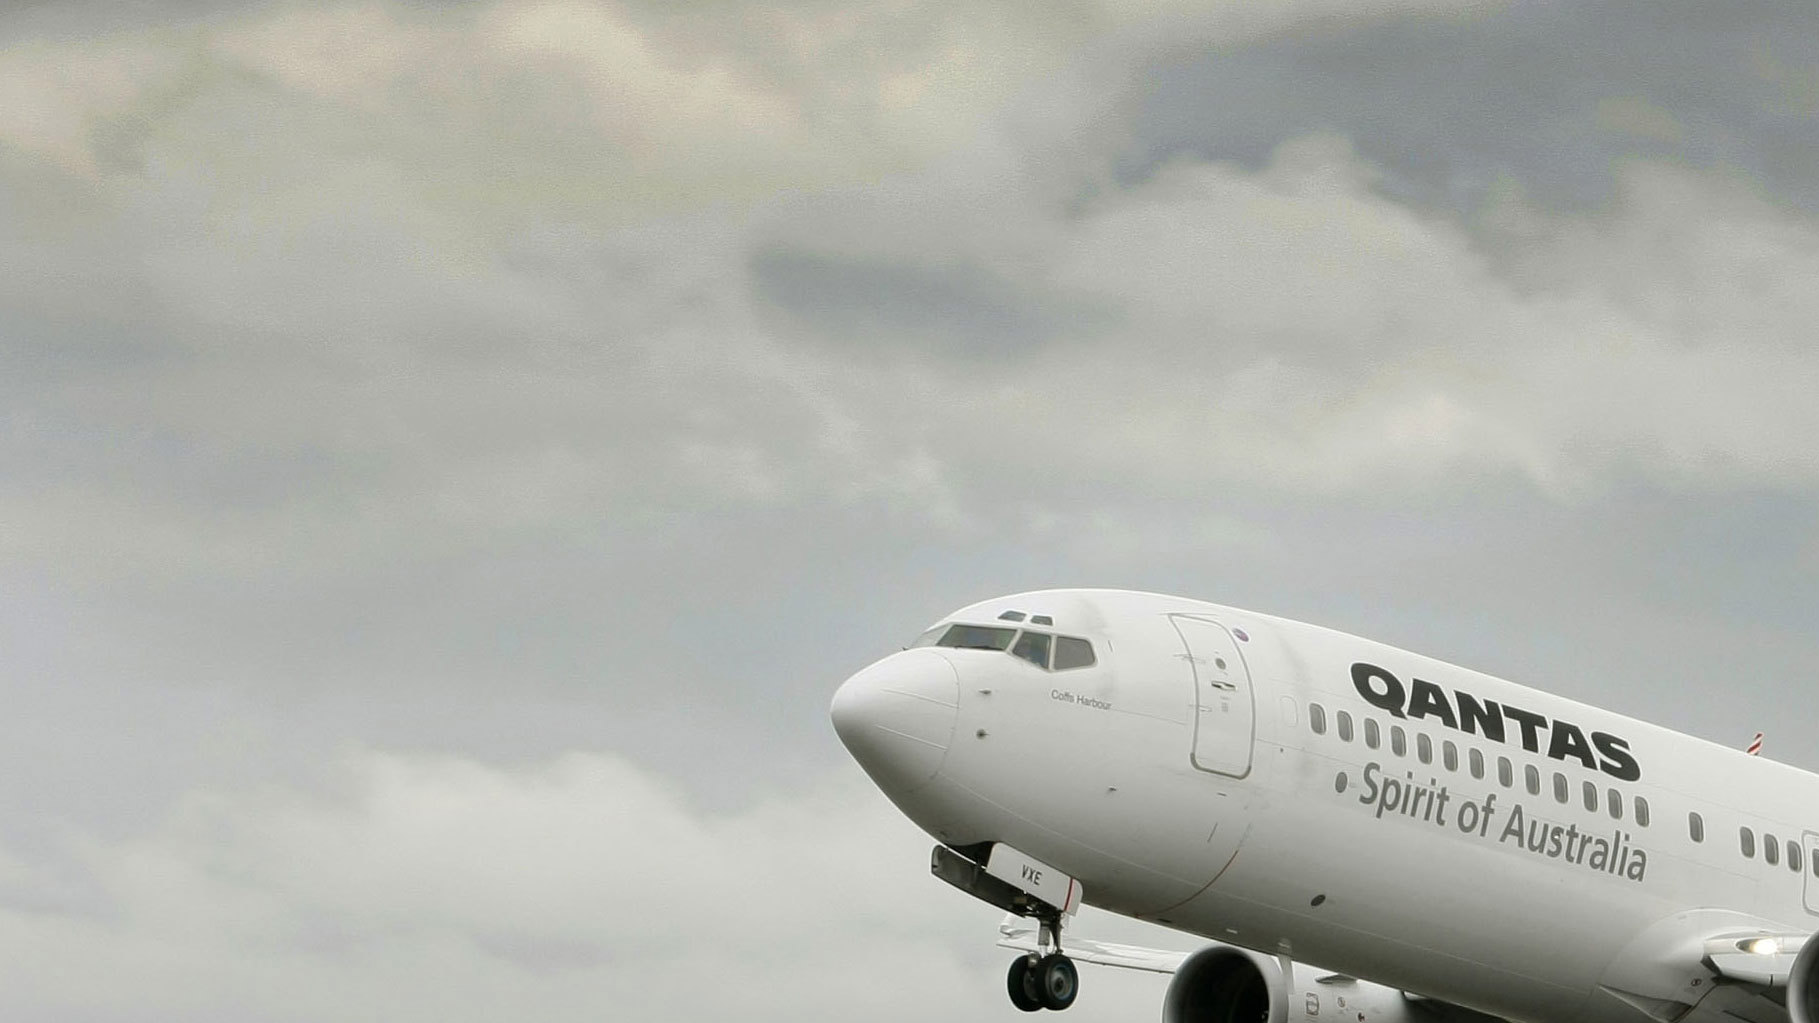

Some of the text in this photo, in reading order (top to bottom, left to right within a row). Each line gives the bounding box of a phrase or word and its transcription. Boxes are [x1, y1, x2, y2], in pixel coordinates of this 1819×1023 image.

[1076, 695, 1112, 710] Harbour
[1351, 662, 1641, 782] QANTAS
[1359, 762, 1647, 882] Spirit of Australia
[1022, 864, 1042, 886] VXE
